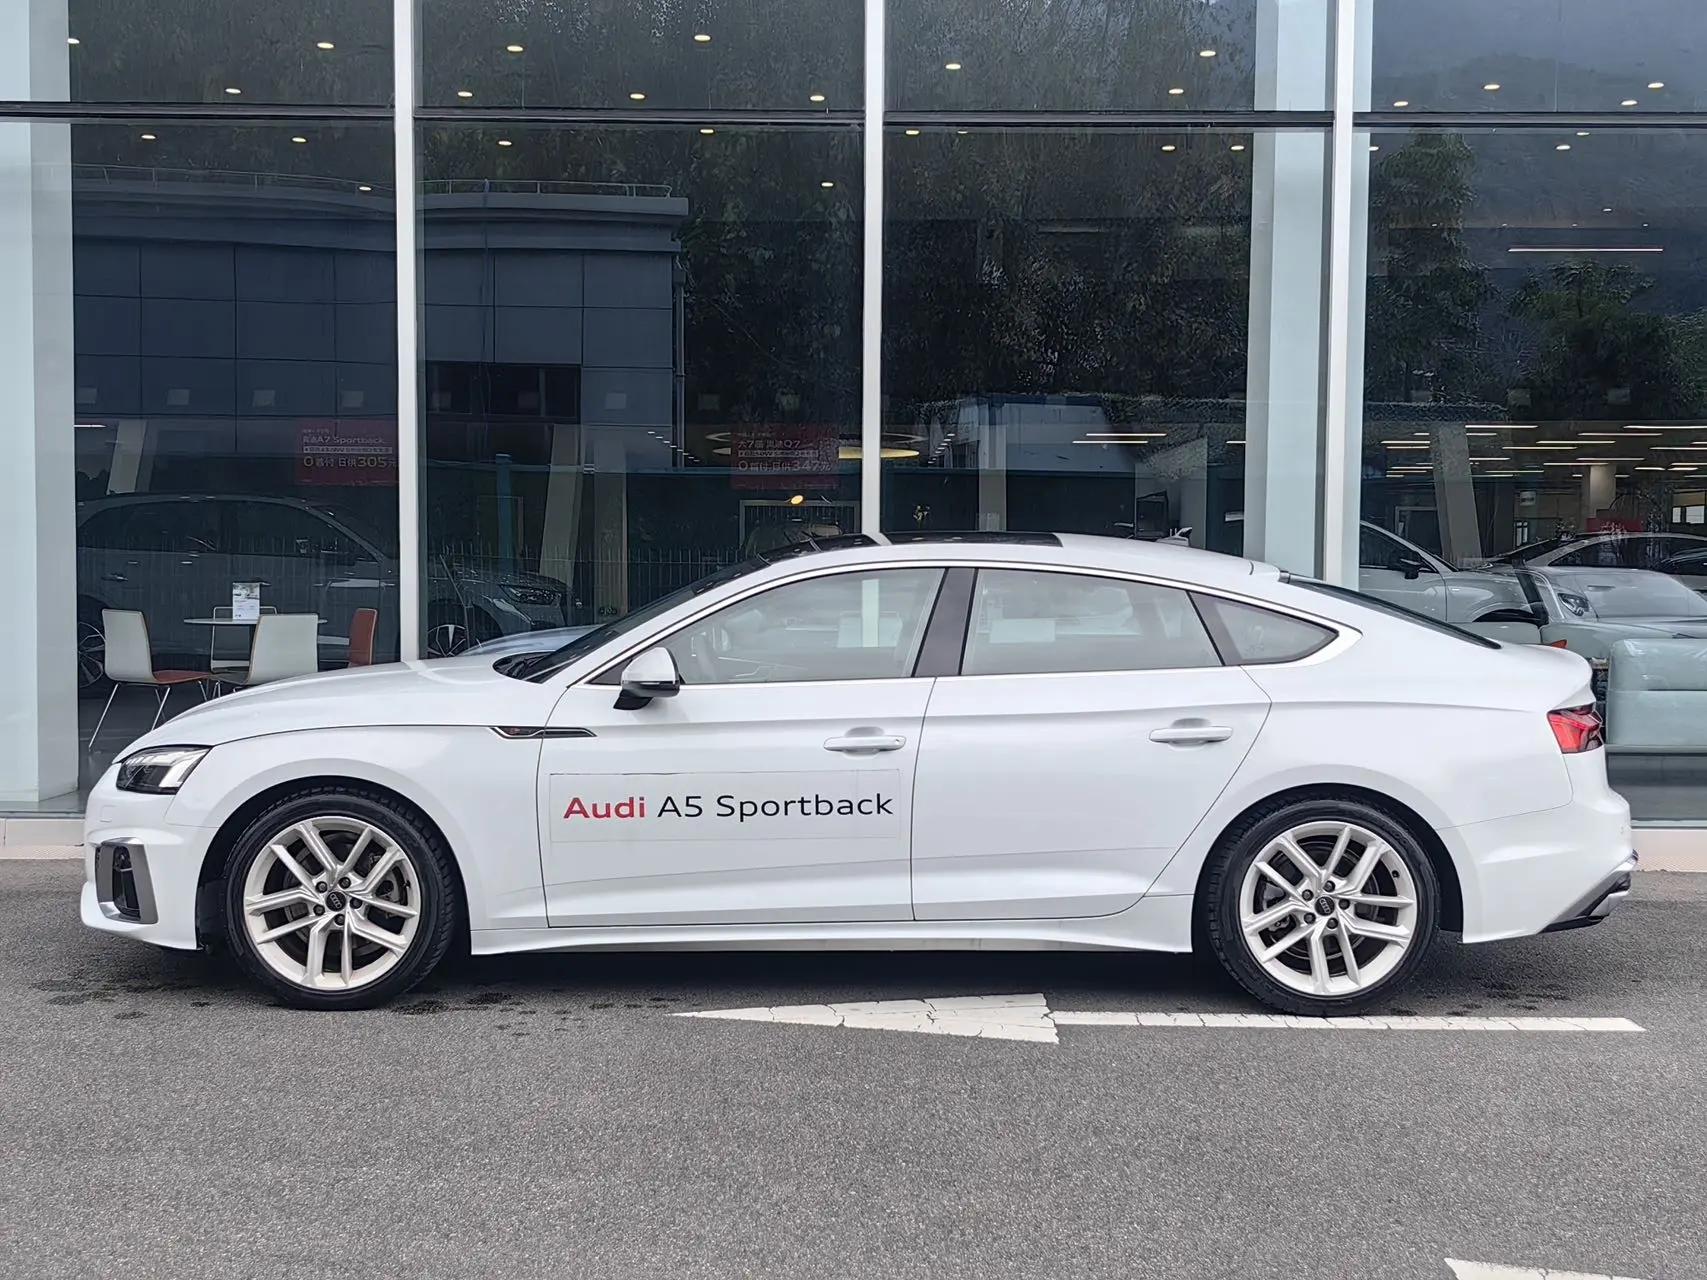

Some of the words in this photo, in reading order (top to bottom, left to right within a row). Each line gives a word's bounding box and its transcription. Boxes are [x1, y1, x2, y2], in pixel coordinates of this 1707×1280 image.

[563, 796, 647, 819] Audi
[657, 795, 703, 818] A5
[716, 793, 894, 823] Sportback
